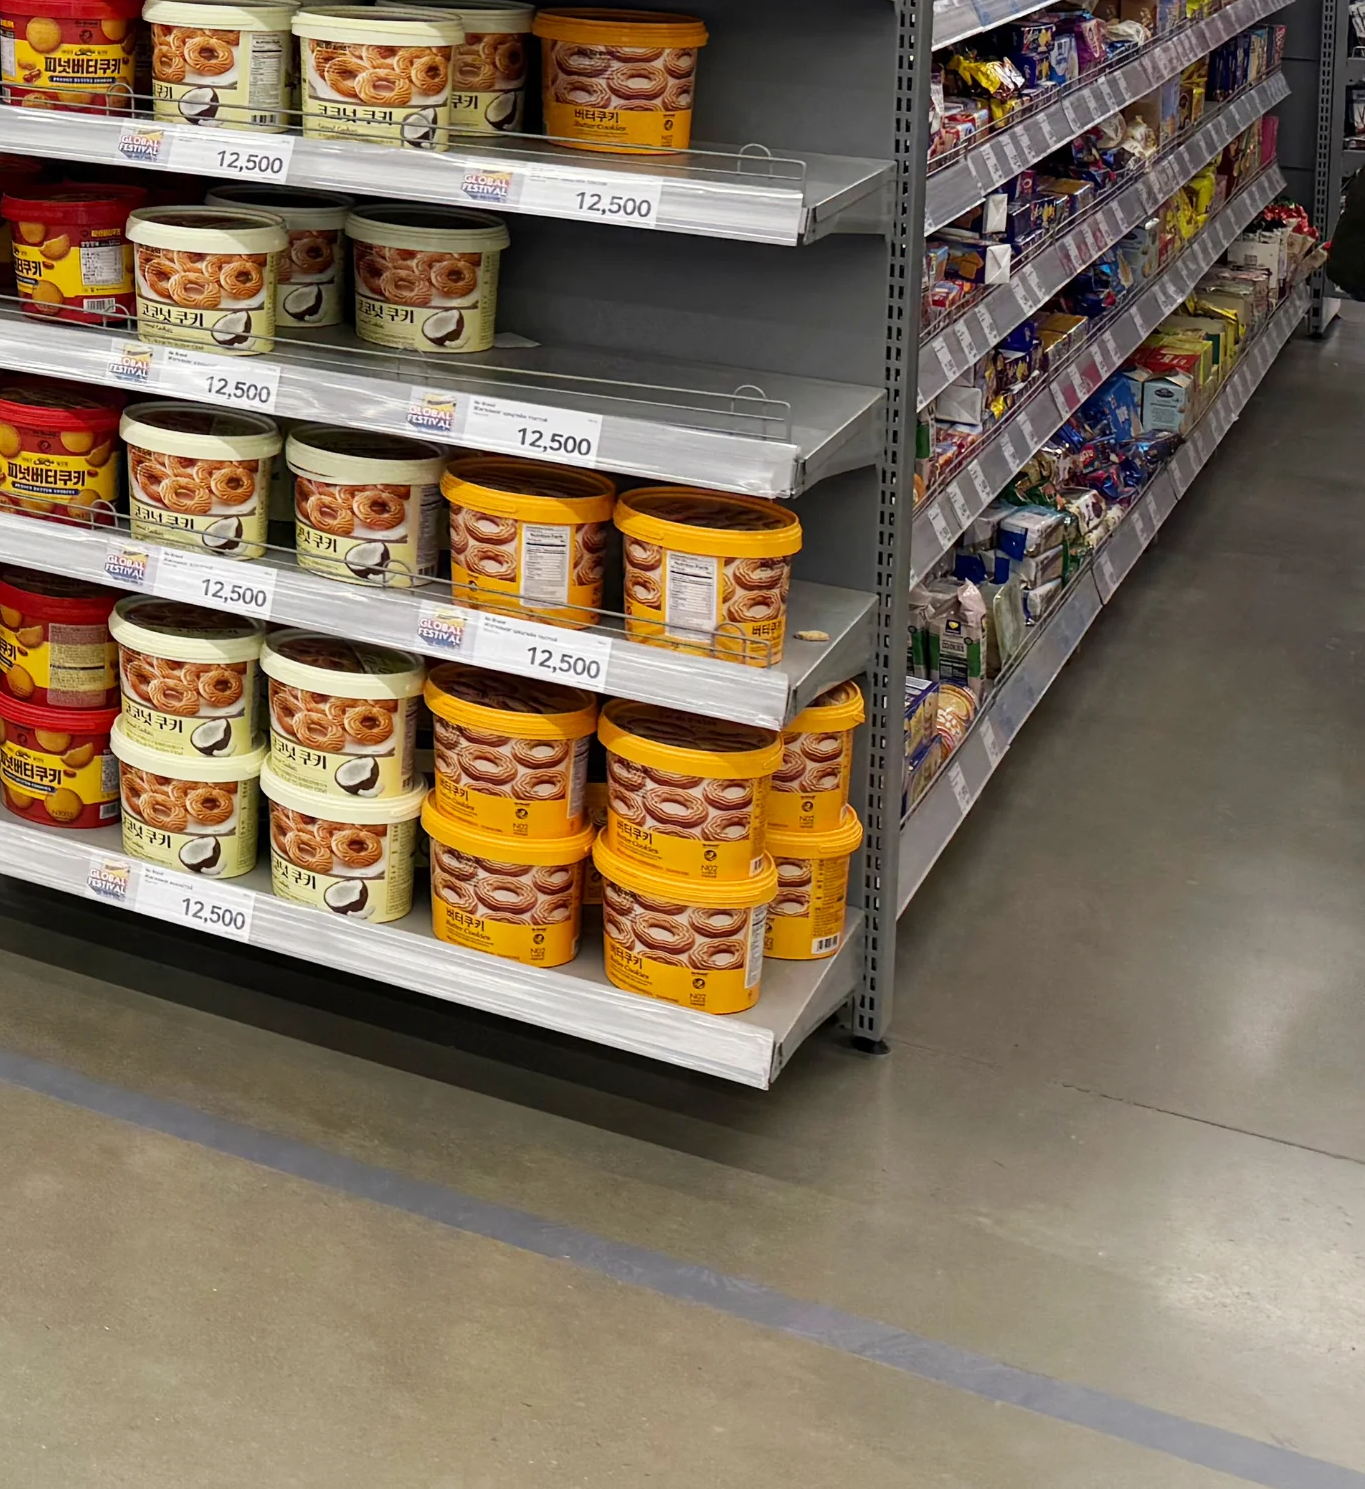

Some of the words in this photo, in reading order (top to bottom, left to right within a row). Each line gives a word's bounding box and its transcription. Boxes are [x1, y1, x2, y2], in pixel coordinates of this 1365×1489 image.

[44, 56, 122, 76] 피넛버터쿠키
[574, 110, 620, 124] 버터쿠키
[120, 135, 160, 147] GLOBAL
[216, 149, 283, 175] 12,500
[464, 173, 508, 188] GLOBAL
[575, 191, 652, 218] 12,500
[176, 309, 204, 328] 쿠키
[205, 376, 271, 403] 12,500
[409, 405, 453, 420] GLOBAL
[517, 427, 592, 457] 12,500
[7, 464, 86, 487] 피넛버터쿠키
[105, 555, 146, 569] GLOBAL
[201, 579, 268, 608] 12,500
[420, 618, 463, 635] GLOBAL
[526, 646, 601, 680] 12,500
[155, 715, 183, 735] 쿠키
[299, 750, 327, 771] 쿠키
[615, 820, 654, 846] 버터쿠키
[90, 868, 127, 884] GLOBAL
[181, 897, 246, 931] 12,500
[445, 908, 485, 932] 버터쿠키
